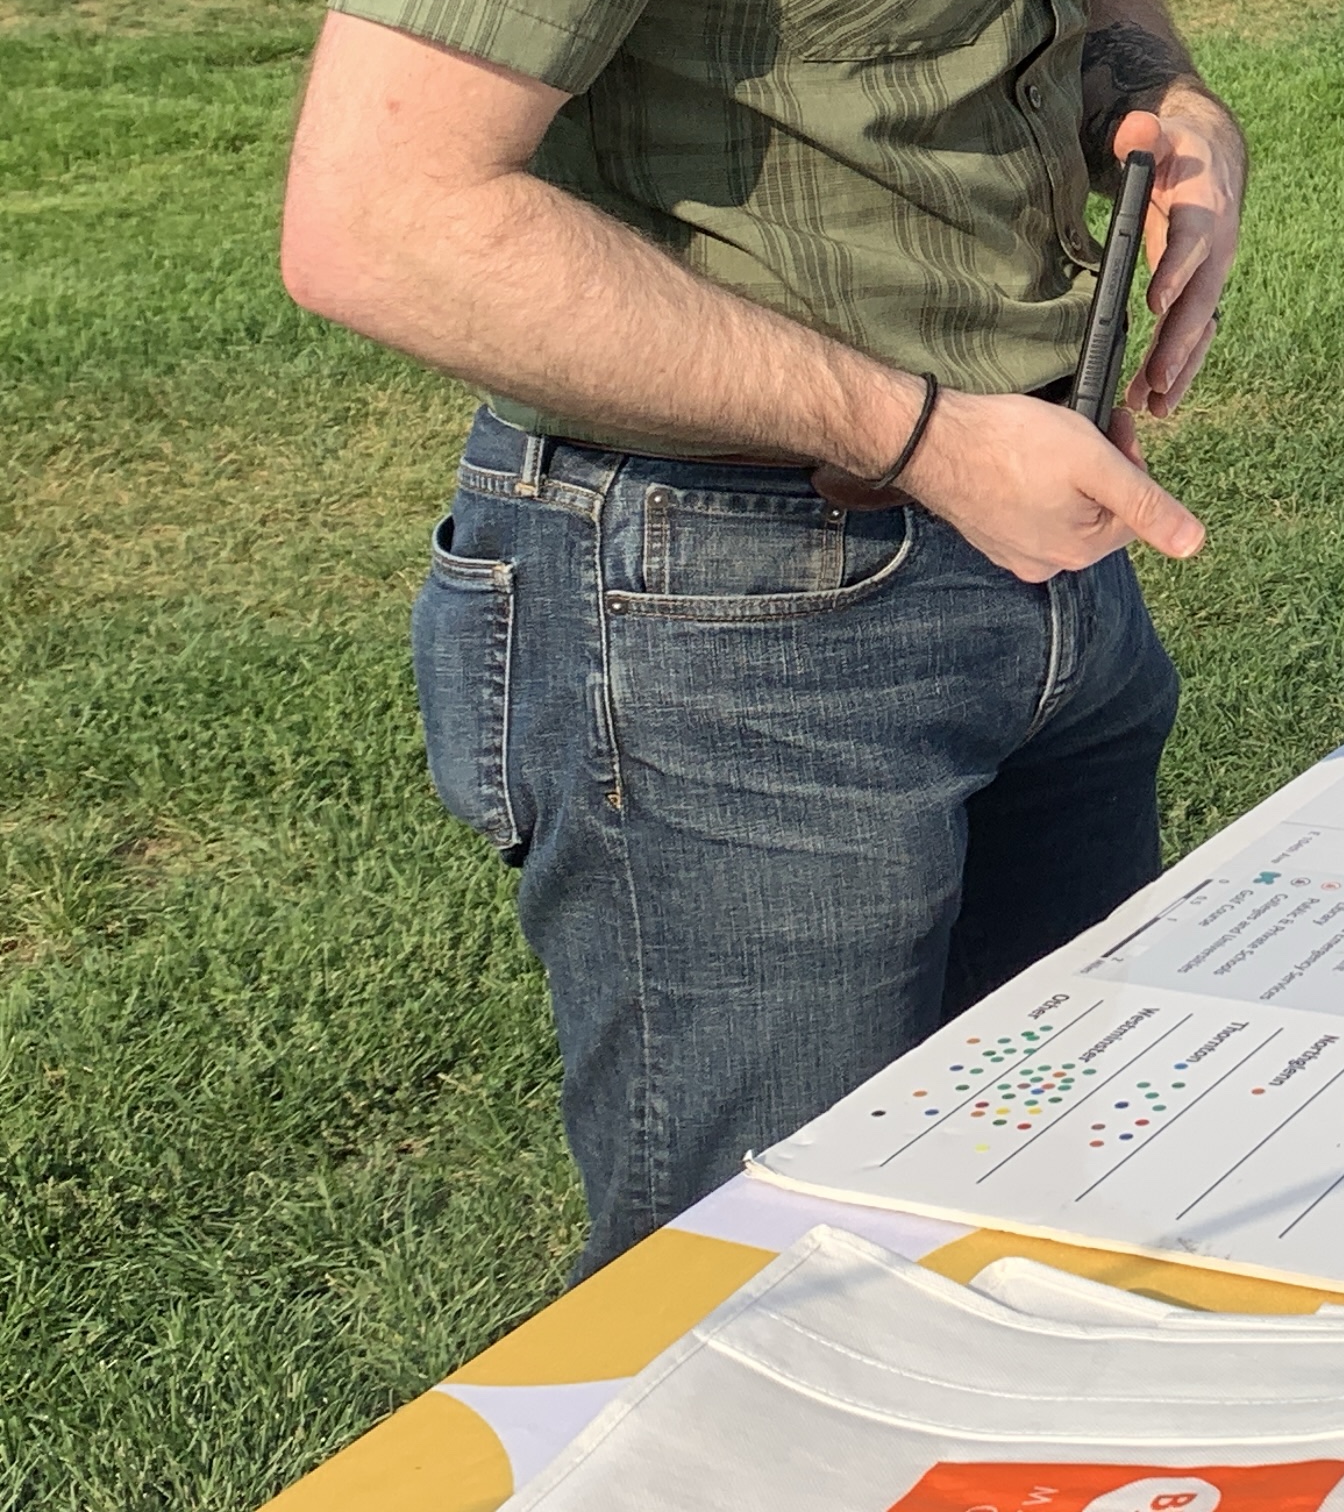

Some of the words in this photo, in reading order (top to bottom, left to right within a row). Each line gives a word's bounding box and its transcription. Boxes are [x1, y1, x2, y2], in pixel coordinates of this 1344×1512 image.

[1270, 852, 1290, 863] Ave
[1198, 904, 1234, 926] Course
[1246, 893, 1287, 920] Colleges
[1286, 897, 1319, 917] Public
[1228, 920, 1249, 934] and
[1247, 925, 1284, 948] Private
[1177, 934, 1235, 972] Universities
[1213, 949, 1253, 975] Schools
[1259, 971, 1302, 999] Services
[1028, 993, 1069, 1019] Other
[1079, 1008, 1157, 1062] Westminster
[1186, 1022, 1248, 1062] Thornton
[1270, 1035, 1337, 1085] Northglenn
